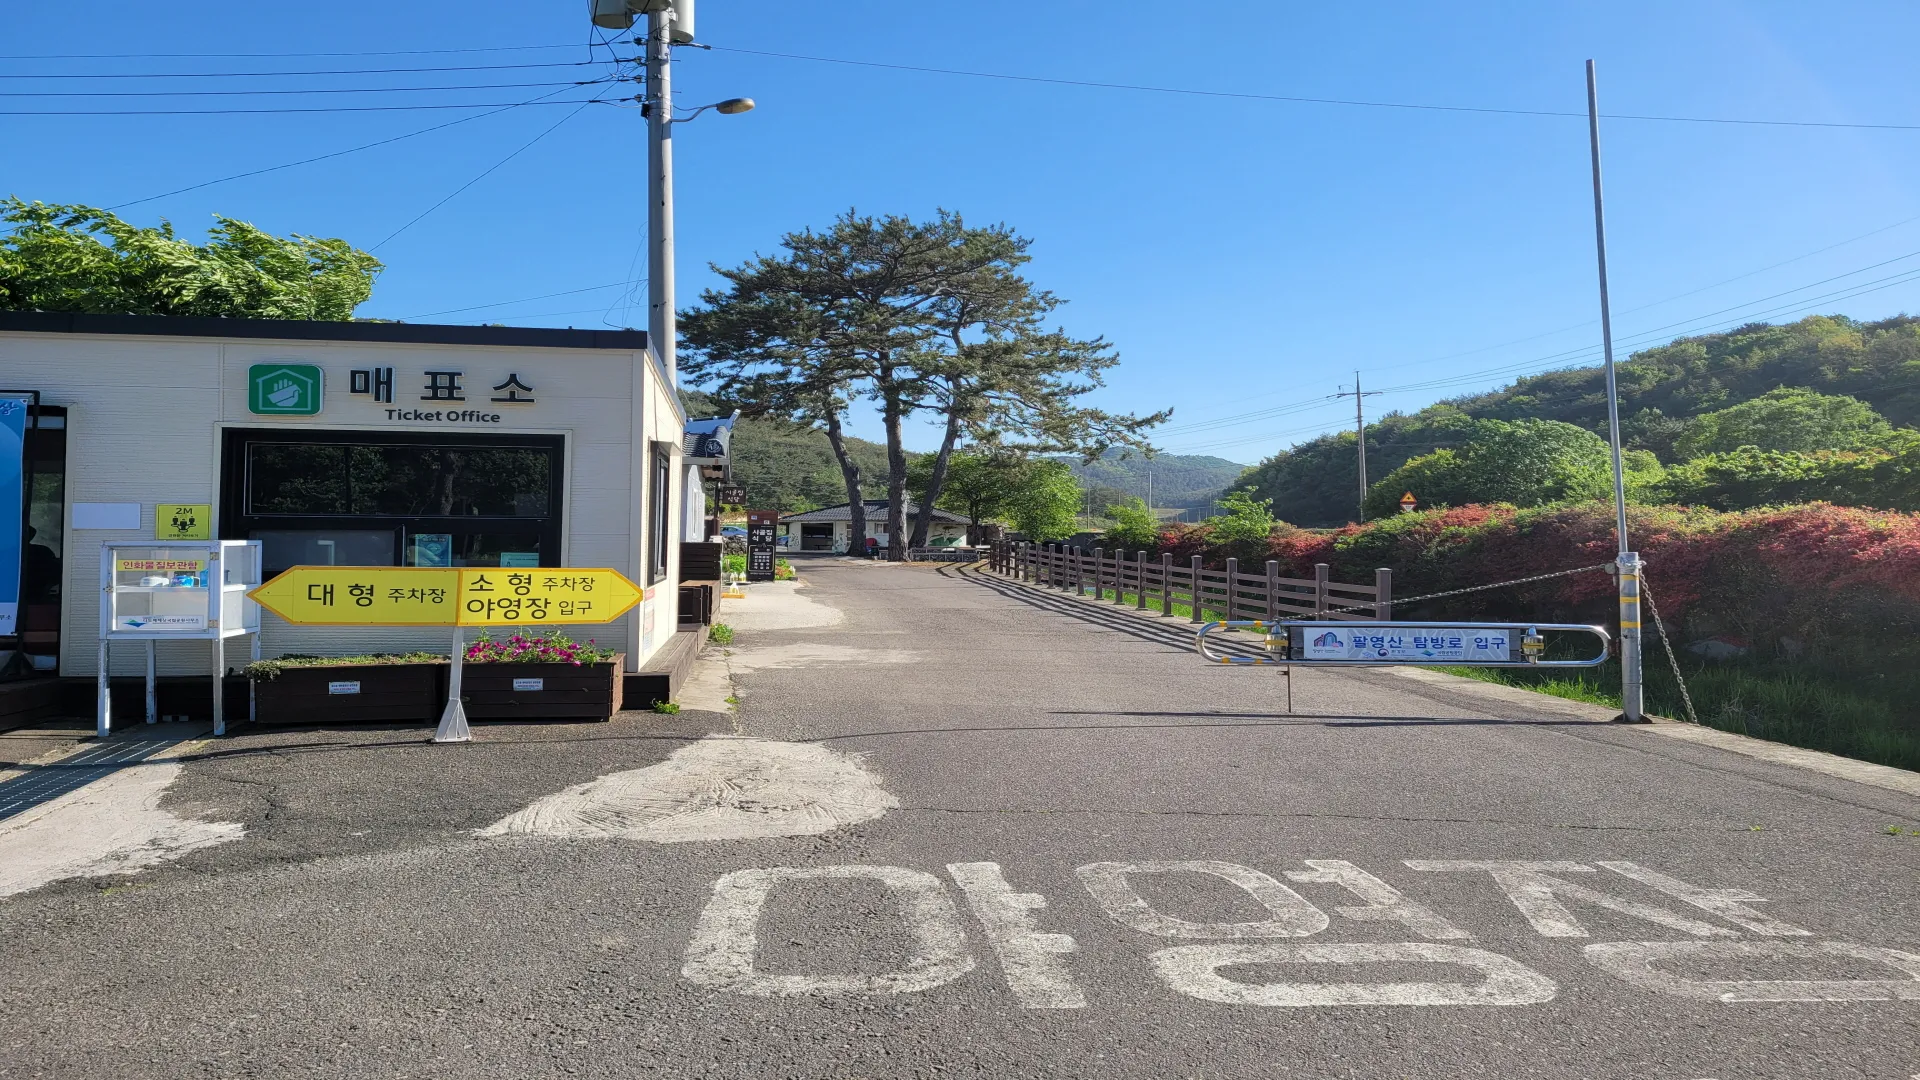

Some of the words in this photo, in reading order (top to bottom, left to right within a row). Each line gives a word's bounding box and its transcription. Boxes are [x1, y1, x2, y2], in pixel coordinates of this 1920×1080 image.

[350, 367, 536, 403] 매표소
[385, 409, 442, 422] Ticket
[446, 410, 501, 423] Office
[175, 507, 193, 515] 2M
[123, 561, 198, 570] 인화물질보관함
[469, 573, 532, 596] 소형
[542, 576, 595, 592] 주차장
[308, 583, 374, 607] 대형
[387, 587, 447, 604] 주차장
[466, 597, 551, 621] 야영장
[559, 601, 593, 616] 입구
[1352, 635, 1403, 649] 팔영산
[1413, 636, 1464, 649] 탐방로
[1474, 637, 1506, 649] 입구
